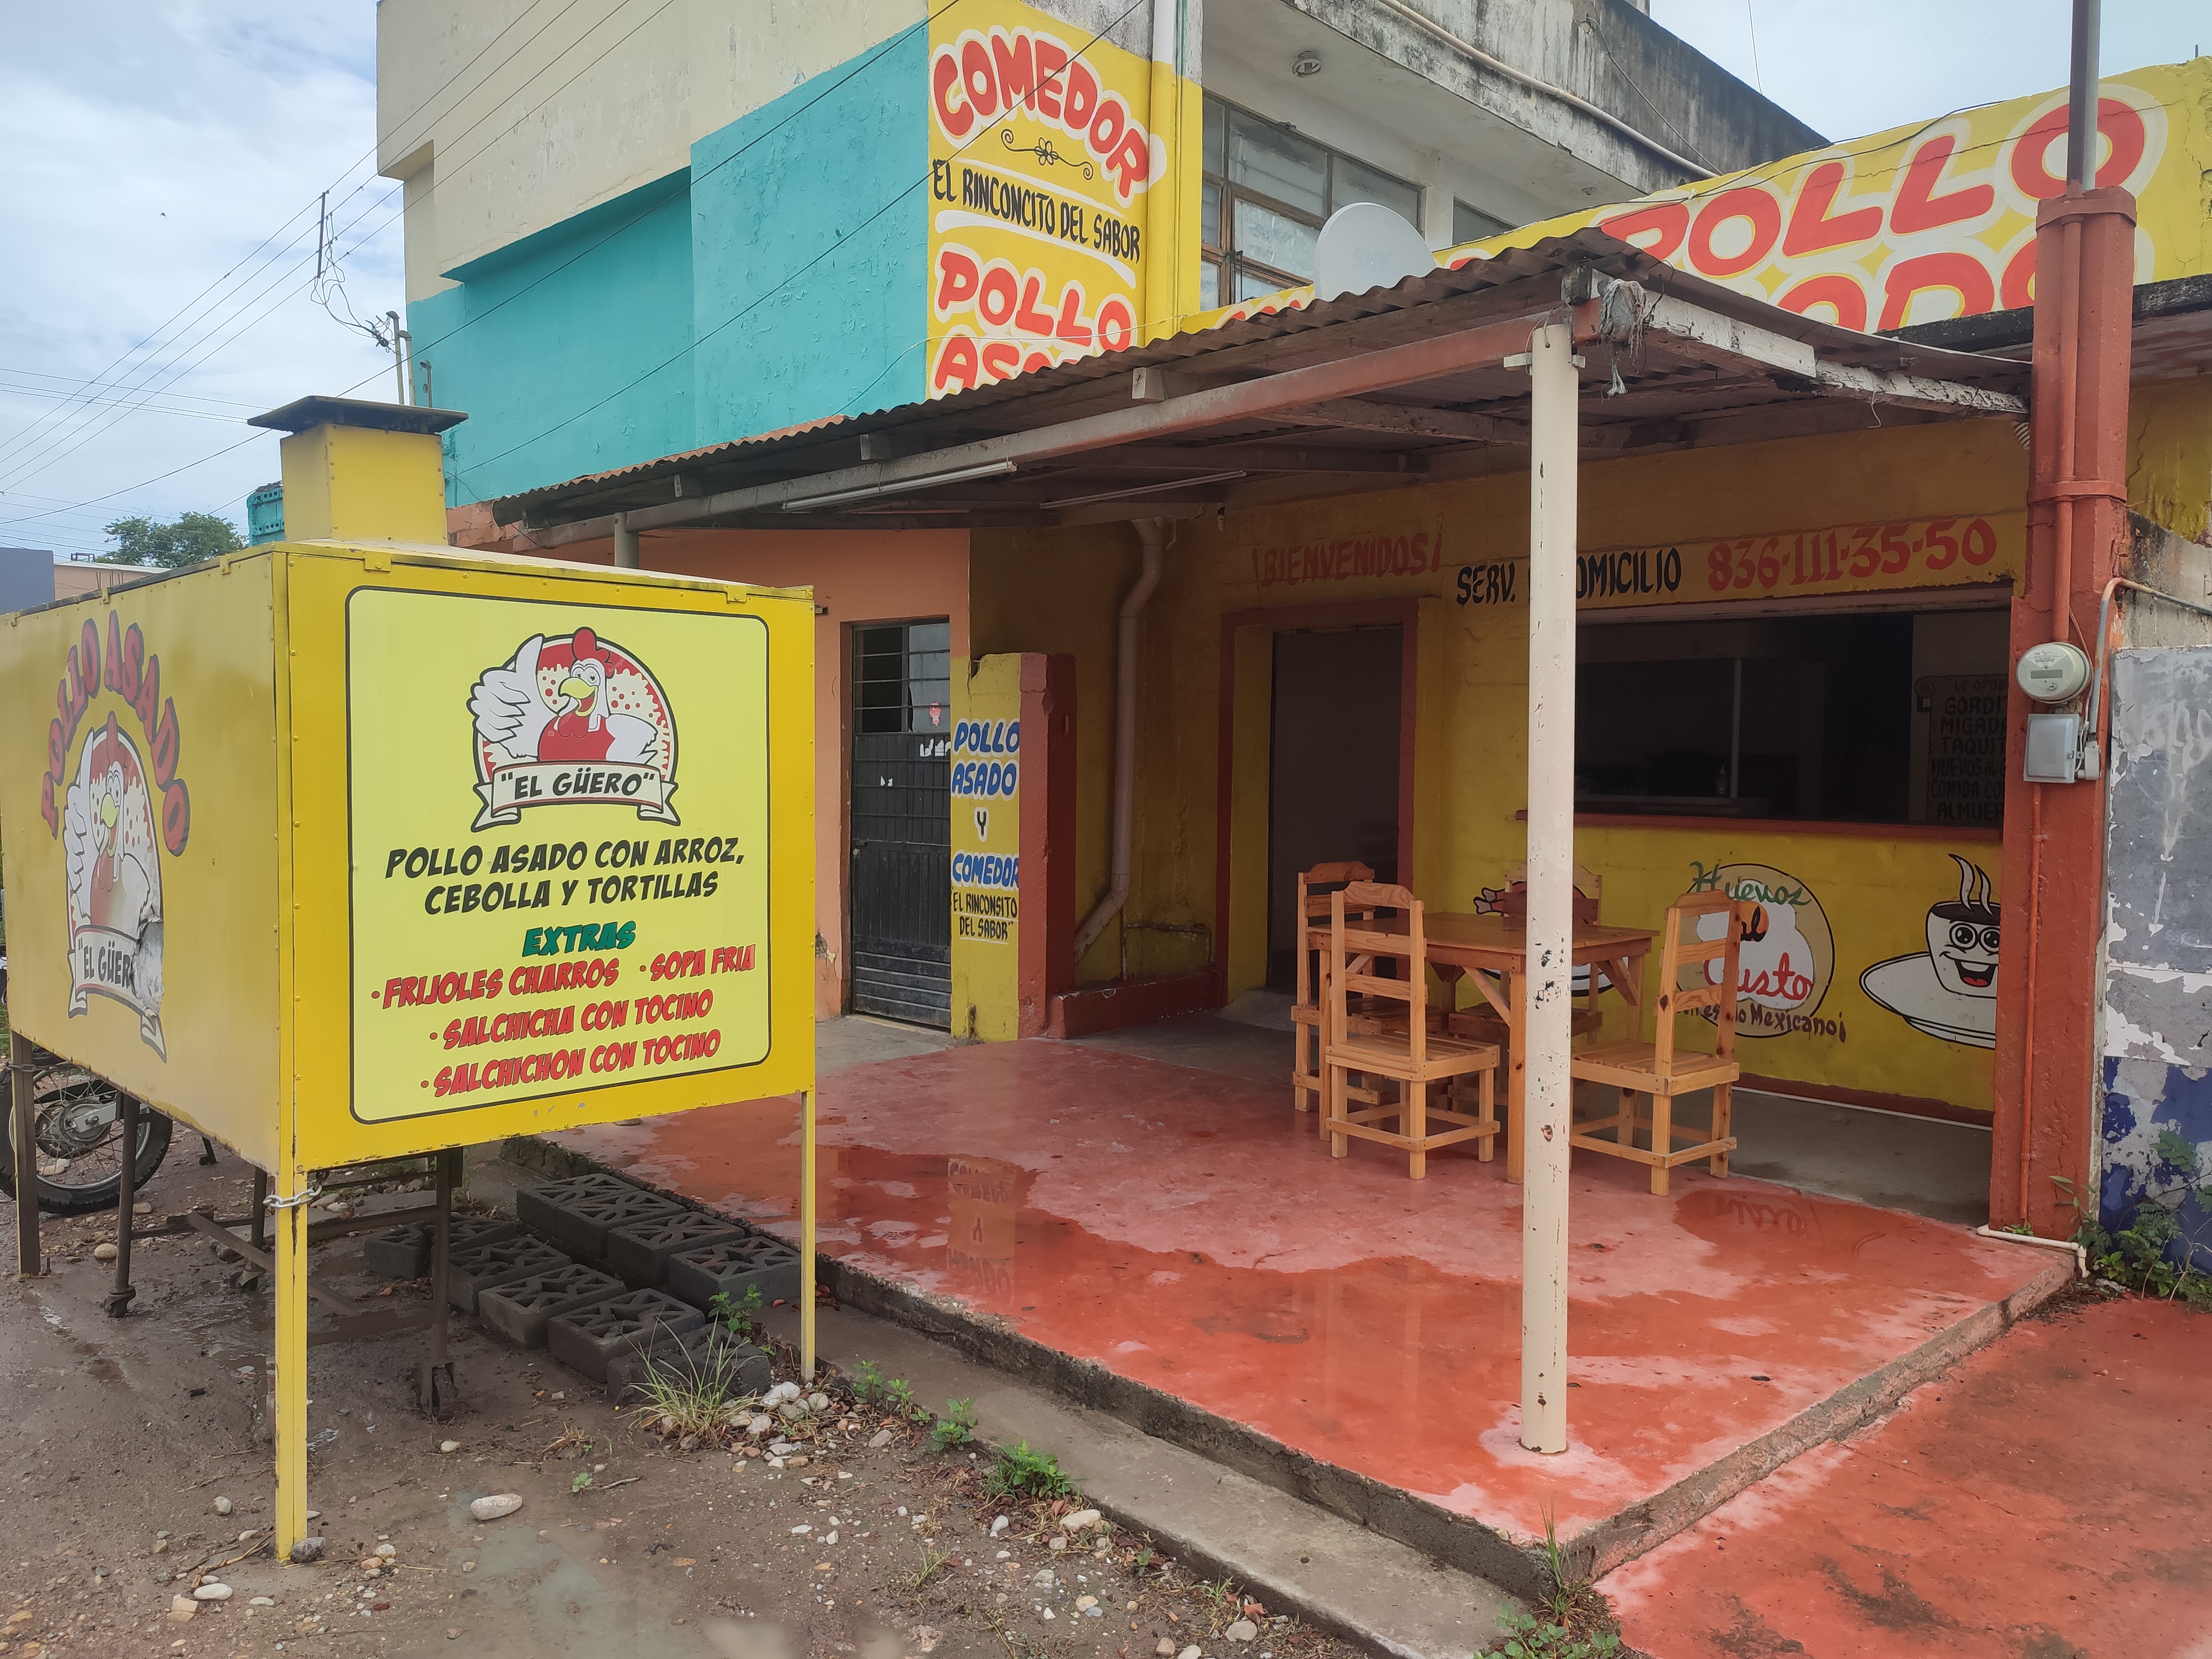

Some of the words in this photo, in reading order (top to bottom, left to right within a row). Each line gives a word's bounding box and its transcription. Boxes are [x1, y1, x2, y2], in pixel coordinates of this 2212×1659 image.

[933, 33, 1150, 200] COMEDOR
[1600, 98, 2146, 278] POLLO
[932, 159, 958, 202] EL
[963, 168, 1056, 235] RINCONCITO
[1060, 201, 1089, 245] DEL
[1094, 213, 1141, 264] SABOR
[938, 251, 1131, 353] POLLO
[1456, 561, 1516, 606] SERV.
[1577, 546, 1682, 599] OMICILIO
[40, 618, 101, 839] POLLO
[105, 609, 191, 858] ASADO
[954, 722, 1020, 753] POLLO
[501, 771, 542, 800] "EL
[552, 766, 655, 797] GÜERO"
[951, 763, 1018, 797] ASADO
[977, 810, 987, 837] Y
[384, 844, 482, 880] POLLO
[488, 840, 588, 876] ASADO
[594, 838, 649, 869] CON
[655, 836, 745, 867] ARROZ,
[952, 853, 1019, 888] COMEDOR
[424, 878, 552, 916] CEBOLLA
[560, 880, 580, 906] Y
[588, 871, 718, 905] TORTILLAS
[966, 892, 1018, 918] RINCONSITO
[522, 919, 637, 958] EXTRAS
[959, 916, 975, 937] DEL
[78, 937, 95, 980] "EL
[98, 940, 131, 990] GÜER
[382, 967, 503, 1011] FRIJOLES
[508, 957, 620, 998] CHARROS
[650, 948, 706, 982] SOPA
[710, 943, 756, 975] FRIA
[443, 1004, 575, 1051] SALCHICHA
[580, 999, 627, 1031] CON
[634, 989, 714, 1026] TOCINO
[432, 1049, 585, 1099] SALCHICHON
[589, 1041, 637, 1074] CON
[643, 1028, 722, 1066] TOCINO
